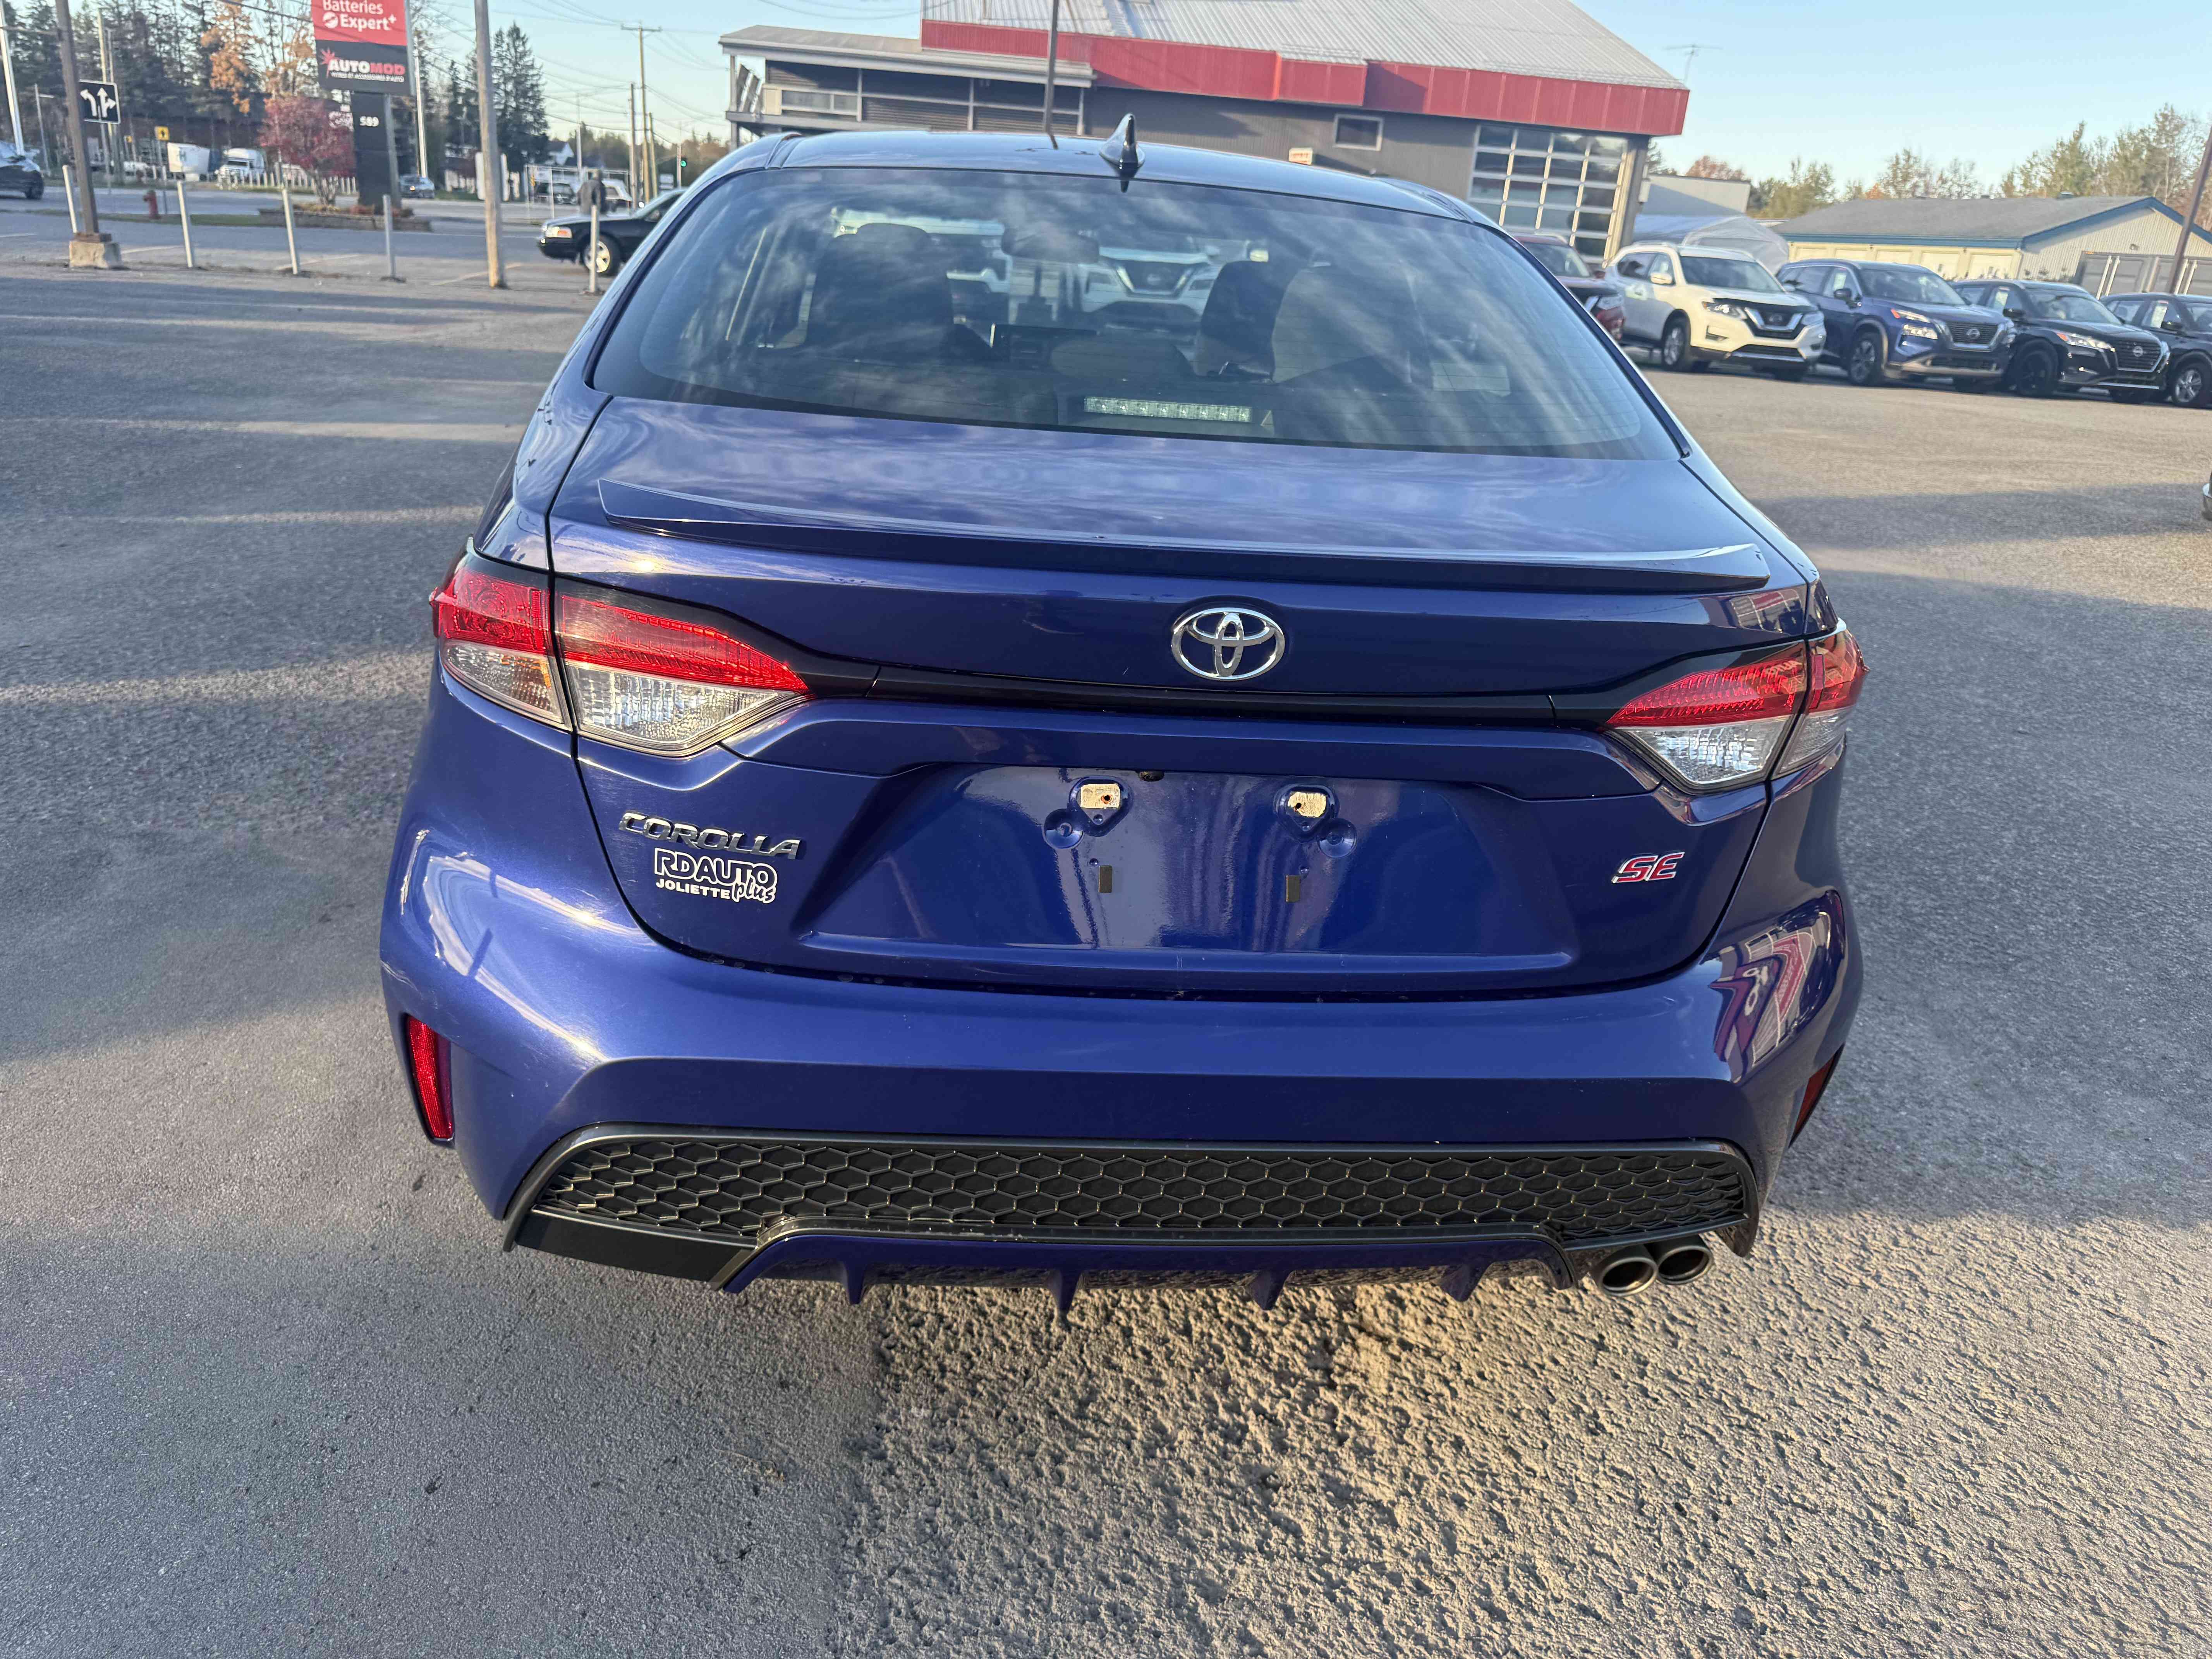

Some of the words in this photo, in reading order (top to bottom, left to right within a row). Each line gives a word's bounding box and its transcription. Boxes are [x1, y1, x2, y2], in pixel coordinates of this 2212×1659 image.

[323, 0, 383, 14] Batteries
[328, 58, 405, 75] AUTOMOD
[619, 811, 802, 860] COROLLA
[1611, 851, 1685, 883] SE
[656, 878, 731, 900] JOLIETTE
[732, 874, 776, 904] plus
